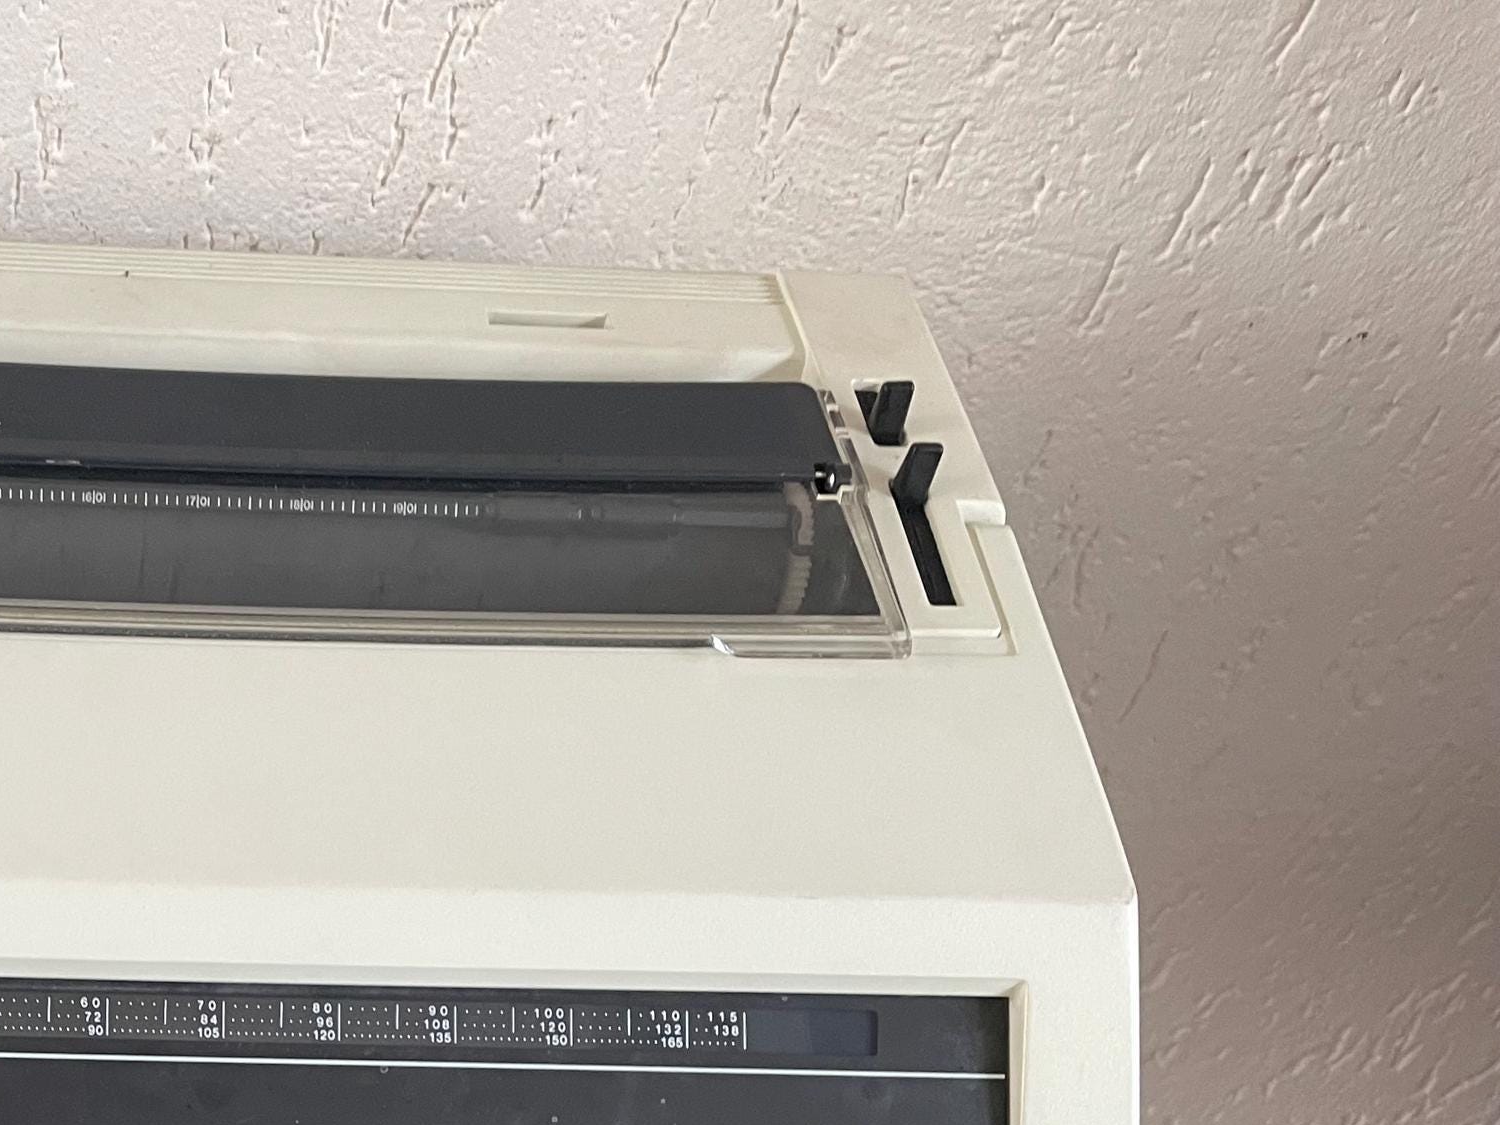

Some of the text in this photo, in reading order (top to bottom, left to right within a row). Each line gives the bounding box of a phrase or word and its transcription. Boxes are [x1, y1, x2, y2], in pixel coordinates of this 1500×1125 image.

[81, 997, 100, 1008] 60
[198, 999, 216, 1011] 70
[312, 1002, 332, 1014] 80
[429, 1005, 448, 1016] 90
[534, 1008, 564, 1019] 100
[650, 1010, 680, 1021] 110
[708, 1011, 738, 1023] 115
[85, 1011, 101, 1022] 72
[200, 1014, 218, 1025] 84
[316, 1017, 333, 1028] 96
[424, 1019, 450, 1030] 108
[540, 1022, 566, 1033] 120
[655, 1024, 682, 1035] 132
[713, 1025, 739, 1036] 138
[88, 1025, 103, 1036] 90
[198, 1027, 219, 1038] 105
[313, 1029, 335, 1041] 120
[429, 1032, 451, 1043] 135
[546, 1034, 567, 1046] 150
[661, 1036, 683, 1048] 165
